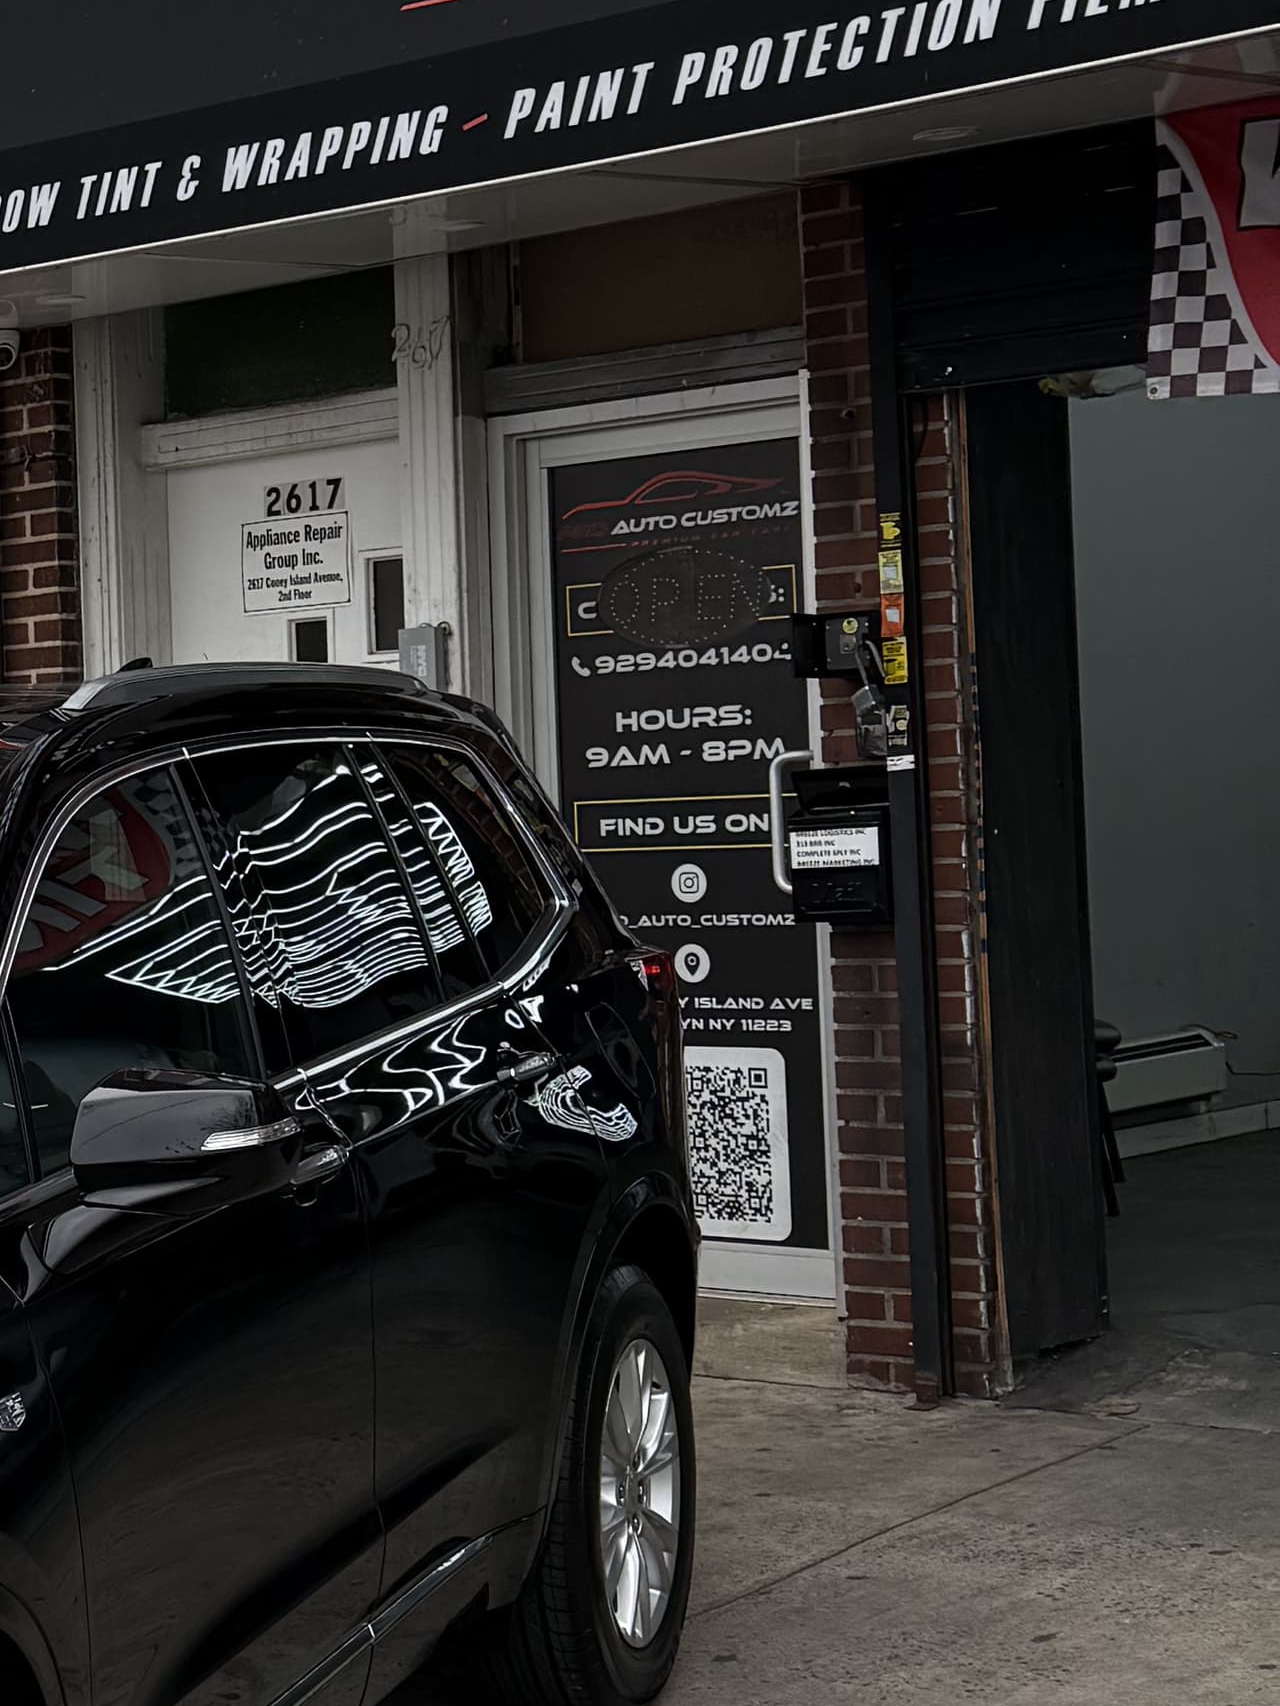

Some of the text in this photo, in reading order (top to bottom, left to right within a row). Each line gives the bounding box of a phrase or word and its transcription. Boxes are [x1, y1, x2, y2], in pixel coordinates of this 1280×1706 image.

[76, 161, 164, 221] TINT
[175, 155, 201, 203] &
[221, 105, 448, 193] WRAPPING
[502, 61, 654, 140] PAINT
[266, 478, 342, 517] 2617
[610, 515, 677, 536] AUTO
[680, 501, 799, 527] CUSTOMZ
[246, 521, 343, 551] Appliance Repair
[264, 548, 324, 570] Group Inc.
[247, 577, 264, 590] 2617
[266, 576, 288, 588] Coney
[290, 574, 312, 586] Island
[278, 589, 312, 602] 2nd Floor
[615, 705, 753, 733] HOURS:
[585, 744, 671, 768] 9AM
[702, 737, 786, 762] 8PM
[600, 813, 769, 837] FIND US ON
[694, 997, 765, 1010] ISLAND
[769, 997, 814, 1010] AVE
[708, 1018, 736, 1031] NY
[740, 1018, 792, 1032] 11223
